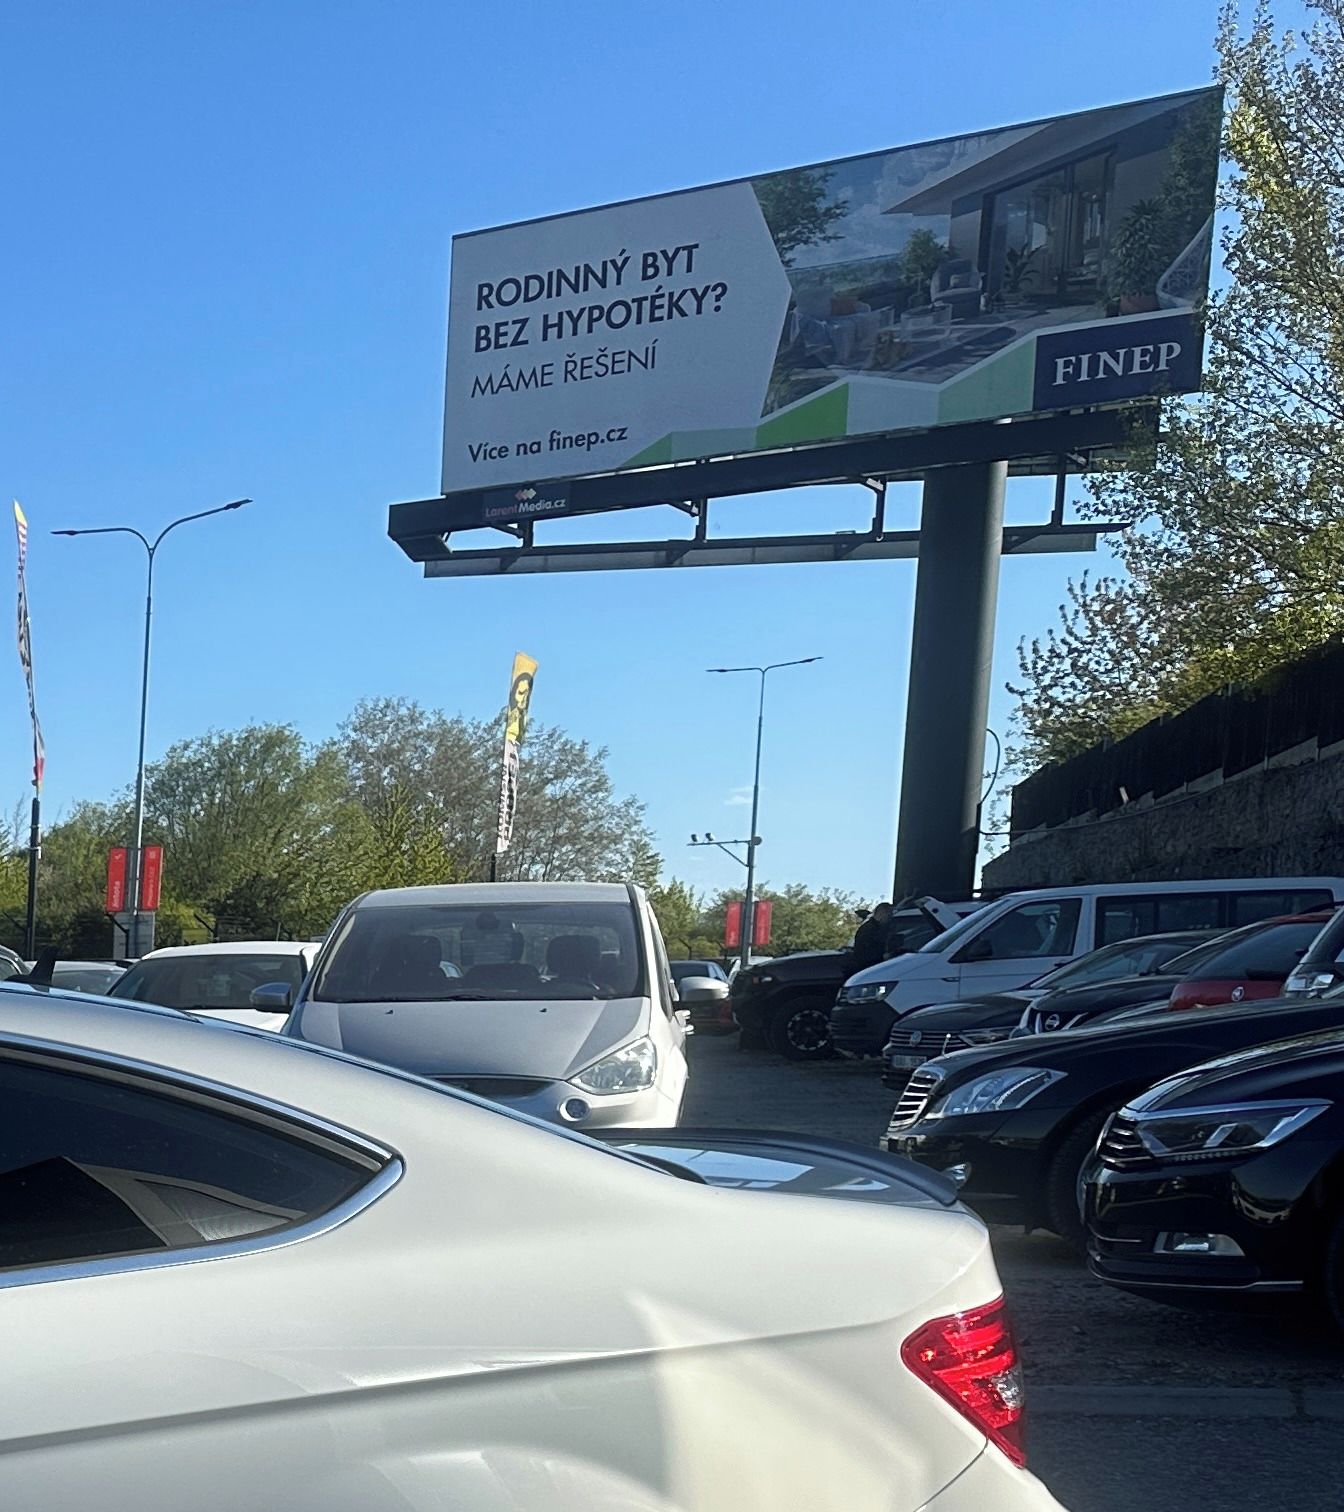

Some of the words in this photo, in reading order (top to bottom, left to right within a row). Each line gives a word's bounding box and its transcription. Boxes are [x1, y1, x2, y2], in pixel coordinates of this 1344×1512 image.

[476, 248, 631, 311] RODINNÝ
[641, 243, 699, 281] BYT
[474, 317, 530, 353] BEZ
[541, 281, 727, 342] HYPOTÉKY?
[470, 363, 554, 398] MÁME
[563, 338, 659, 383] ŘEŠENÍ
[1051, 341, 1182, 386] FINEP
[468, 441, 509, 463] Více
[516, 440, 542, 456] na
[548, 426, 629, 451] finep.cz
